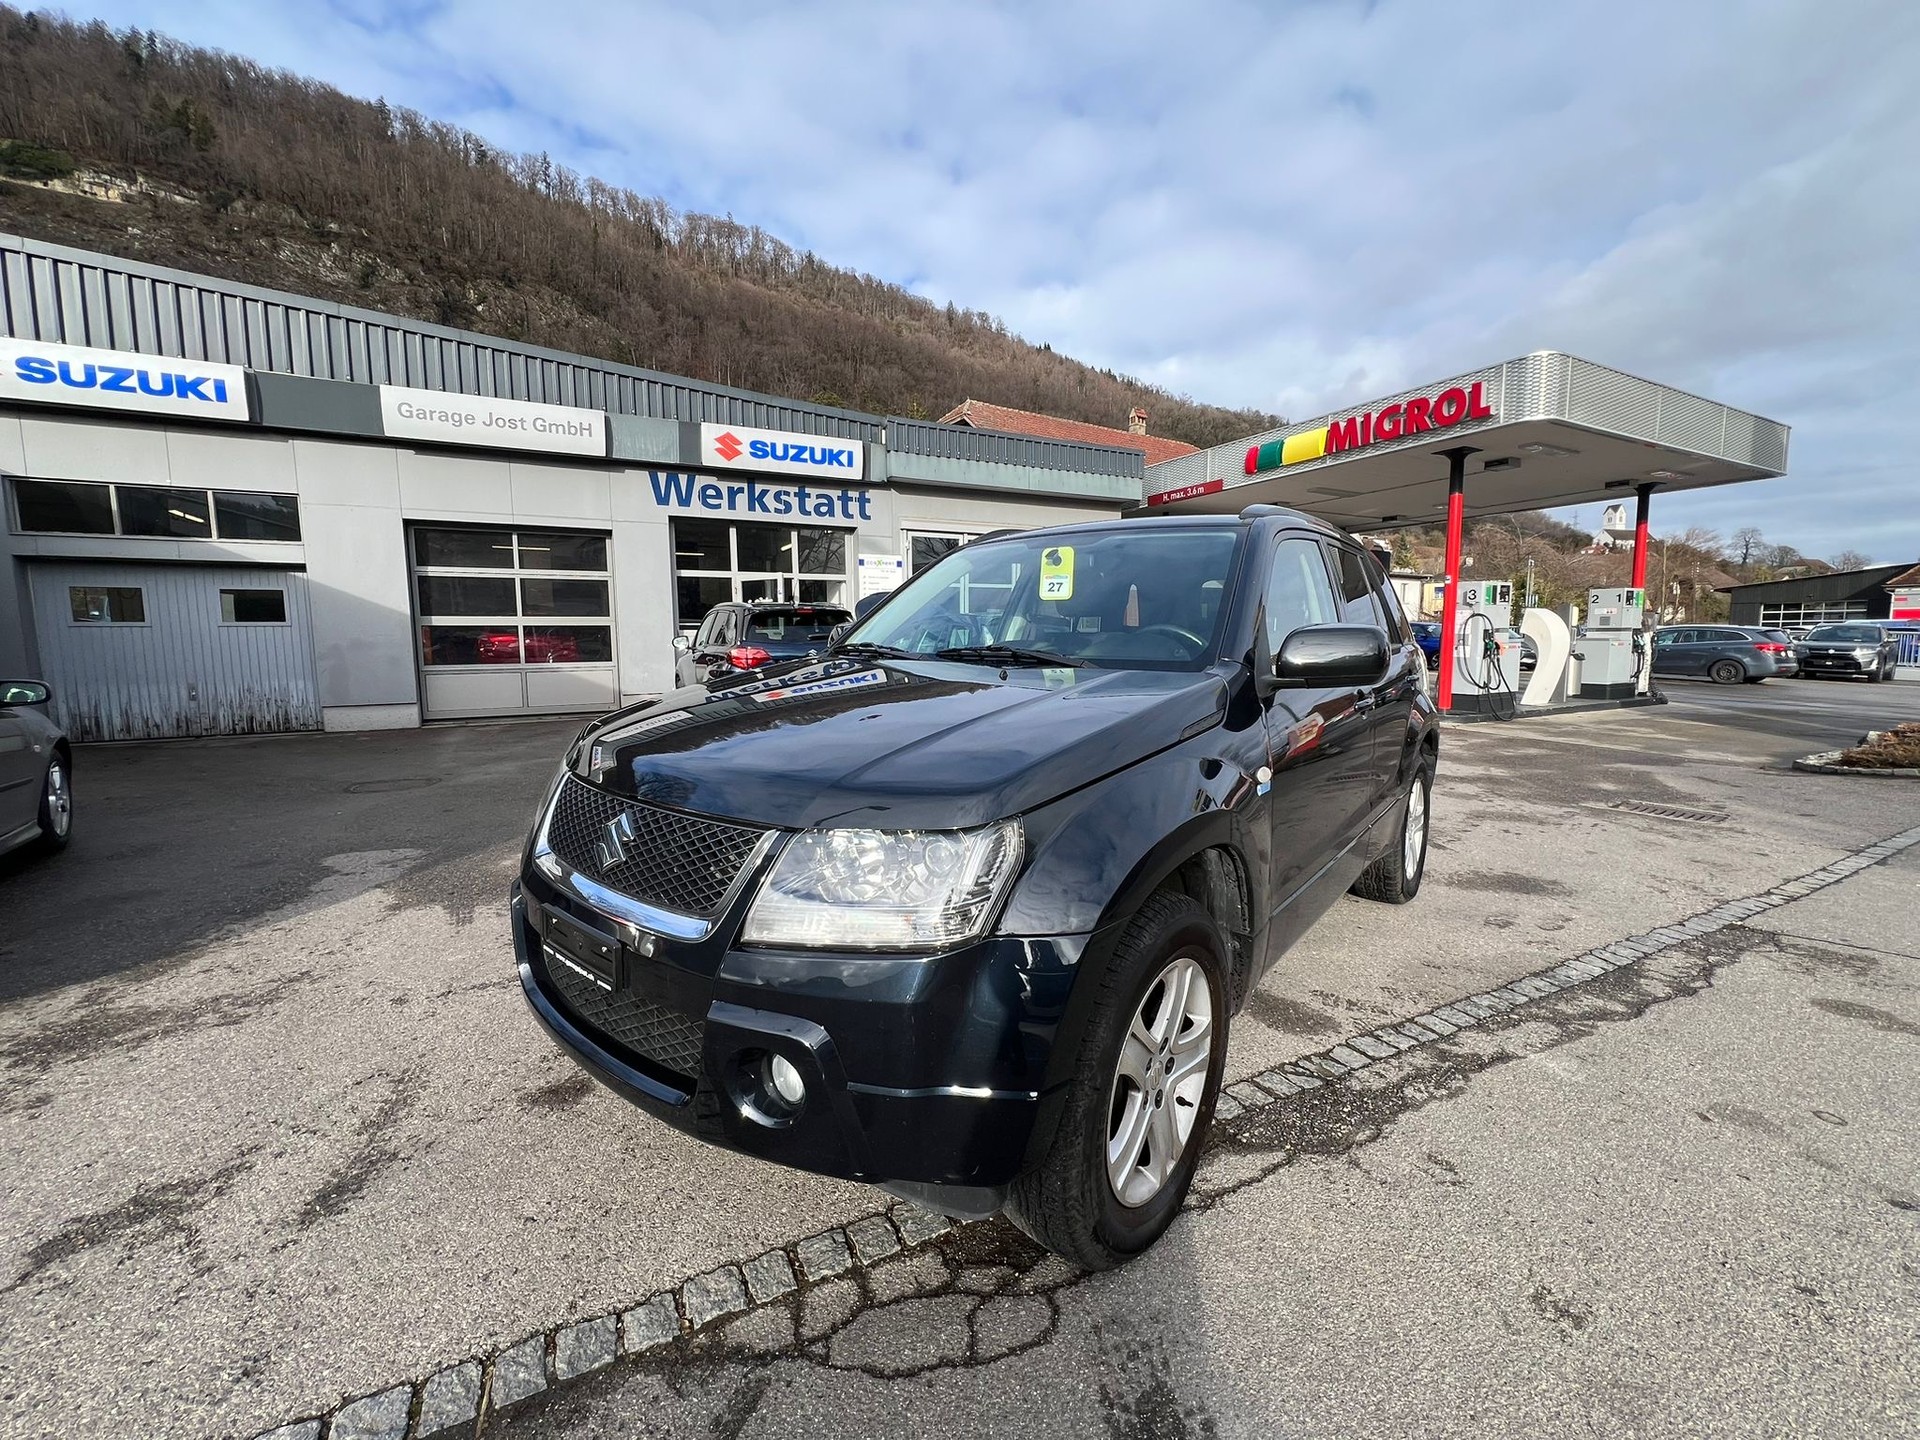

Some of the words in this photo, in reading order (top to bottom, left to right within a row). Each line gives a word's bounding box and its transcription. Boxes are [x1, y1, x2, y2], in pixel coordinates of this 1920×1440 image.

[15, 356, 228, 403] SUZUKI
[397, 401, 476, 428] Garage
[482, 411, 528, 431] Jost
[532, 417, 593, 438] GmbH
[1325, 381, 1491, 455] MIGROL
[749, 439, 854, 468] SUZUKI
[648, 470, 872, 521] Werkstatt
[1162, 493, 1170, 502] H.
[1170, 490, 1186, 500] max.
[1047, 582, 1064, 592] 27
[1468, 589, 1477, 600] 3
[1591, 594, 1600, 604] 2
[1616, 593, 1622, 603] 1
